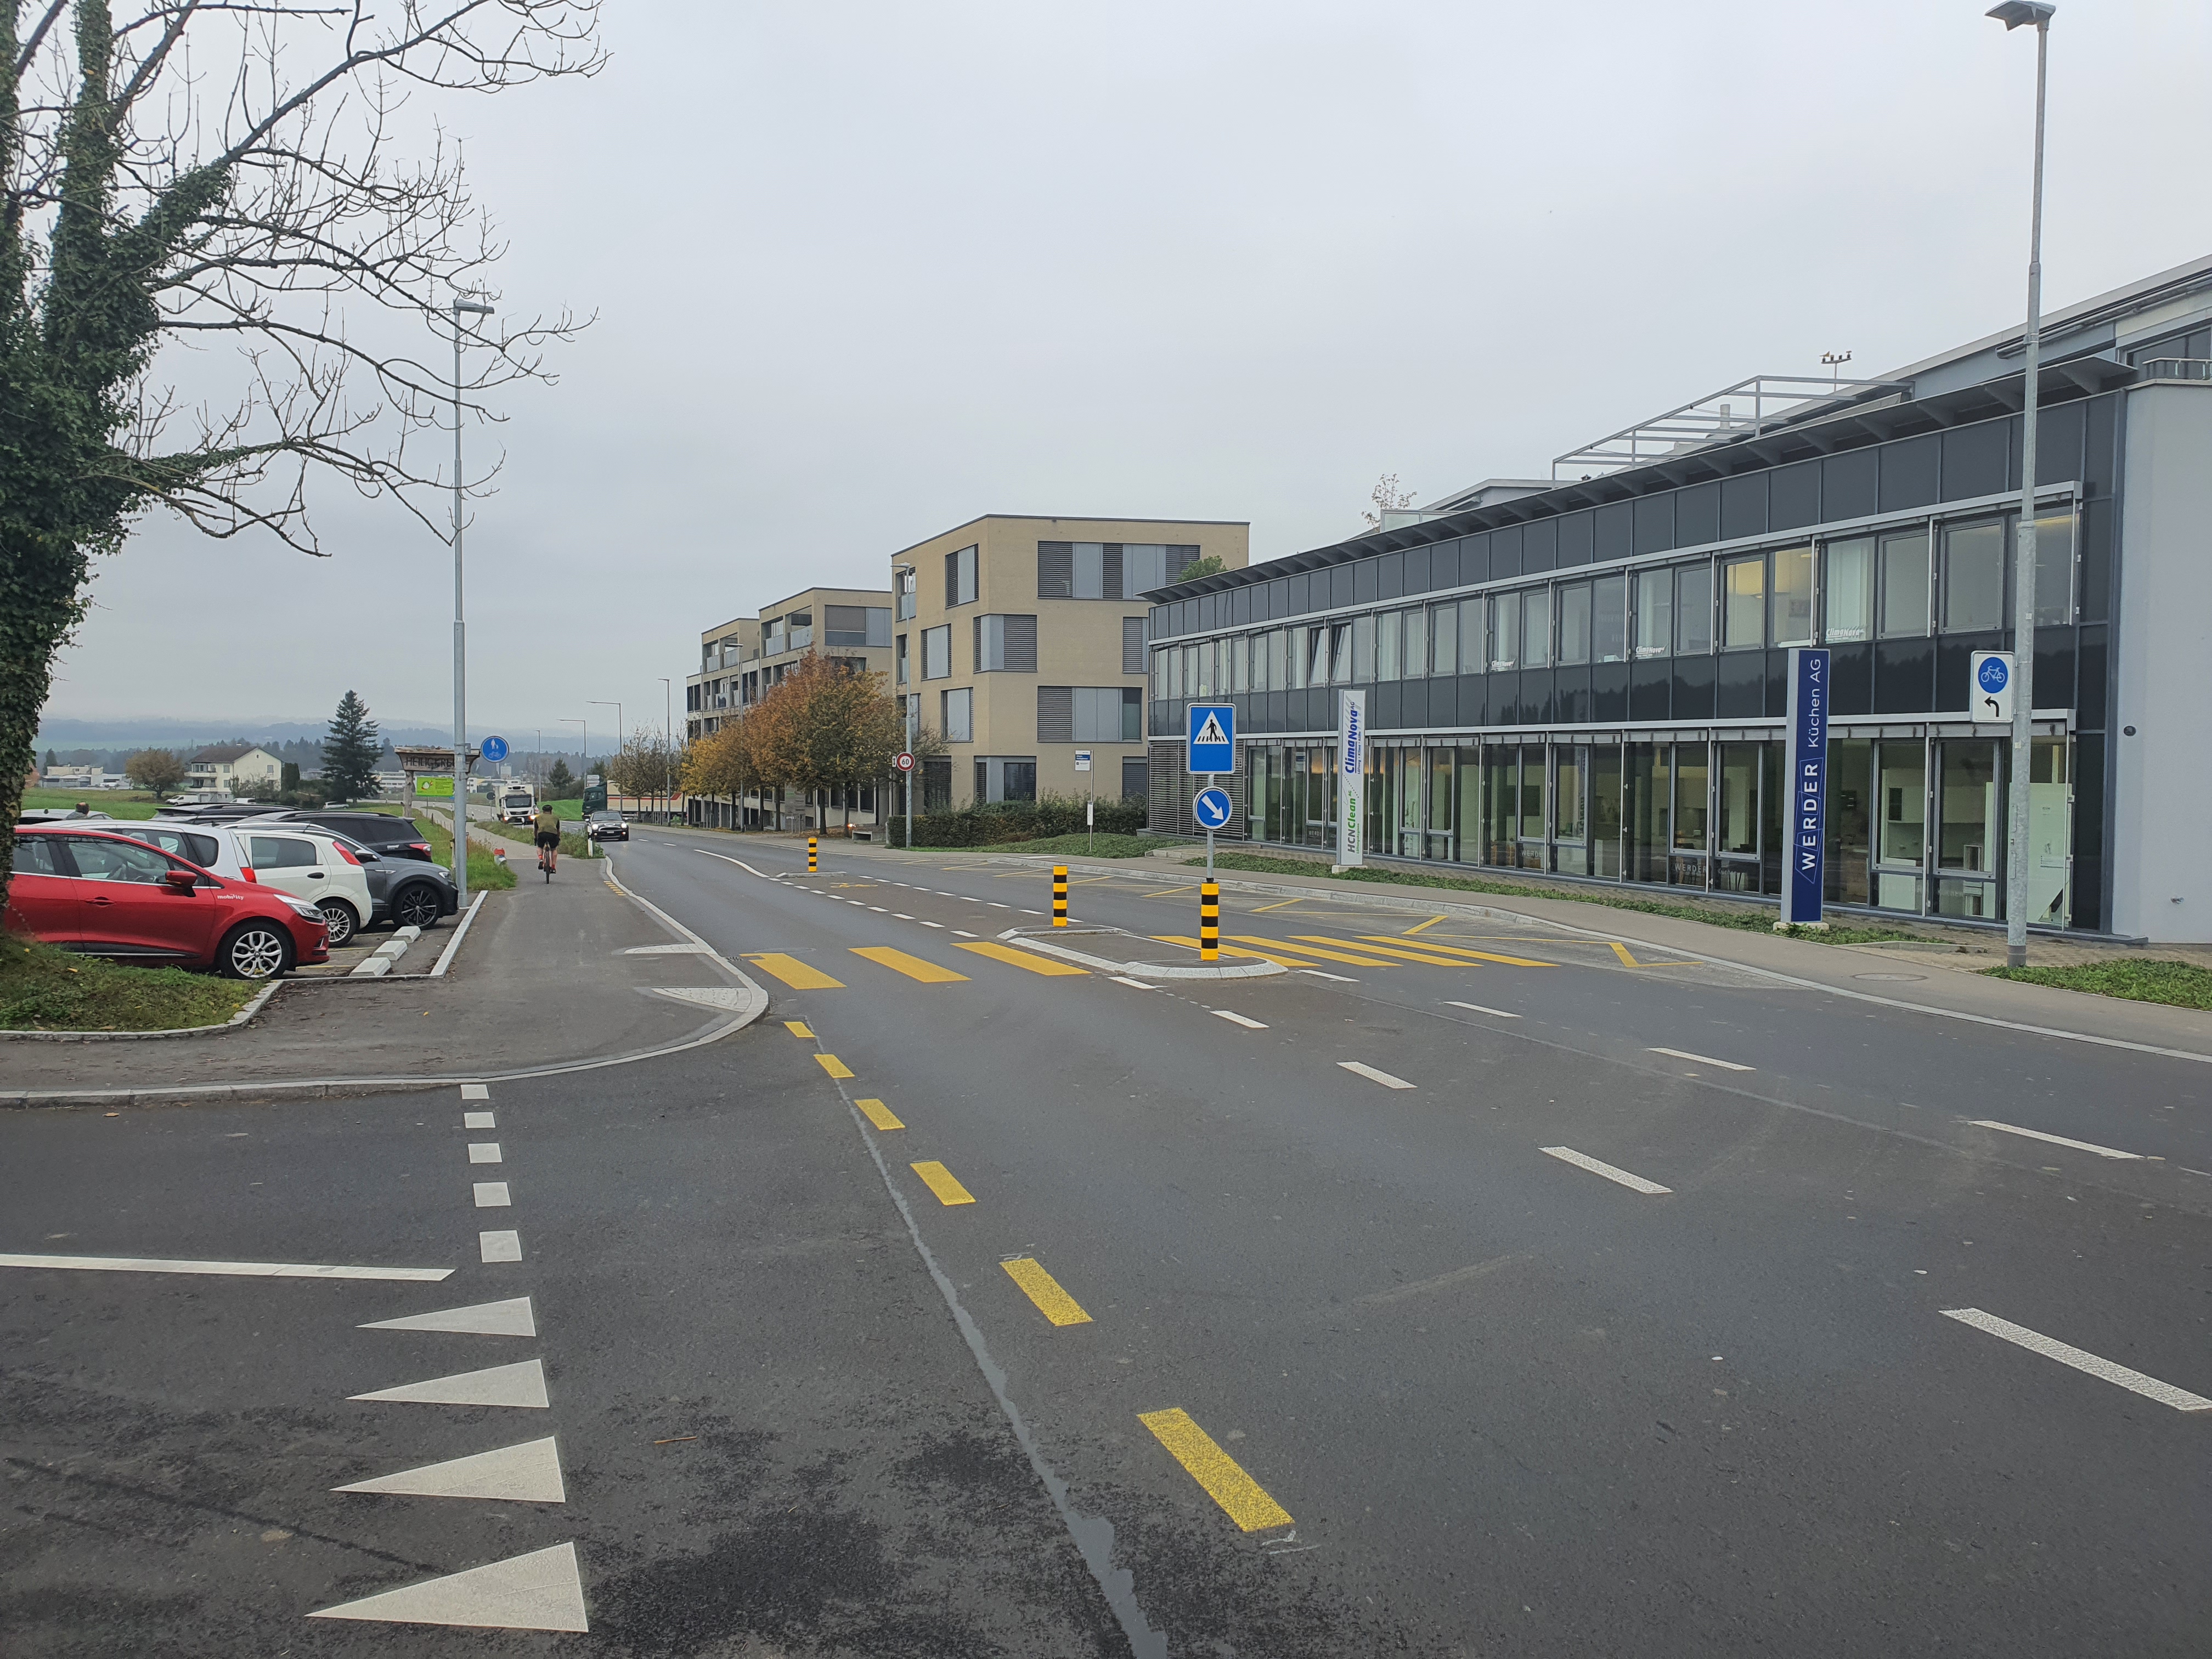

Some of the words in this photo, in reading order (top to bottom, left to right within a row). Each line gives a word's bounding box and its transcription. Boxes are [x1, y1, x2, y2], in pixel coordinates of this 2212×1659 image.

[1810, 659, 1821, 683] AG
[1350, 702, 1355, 710] AG
[1808, 689, 1820, 747] Küchen
[1345, 709, 1358, 774] ClimaNova
[1347, 798, 1356, 853] HCNClean
[1802, 764, 1818, 870] WERDER
